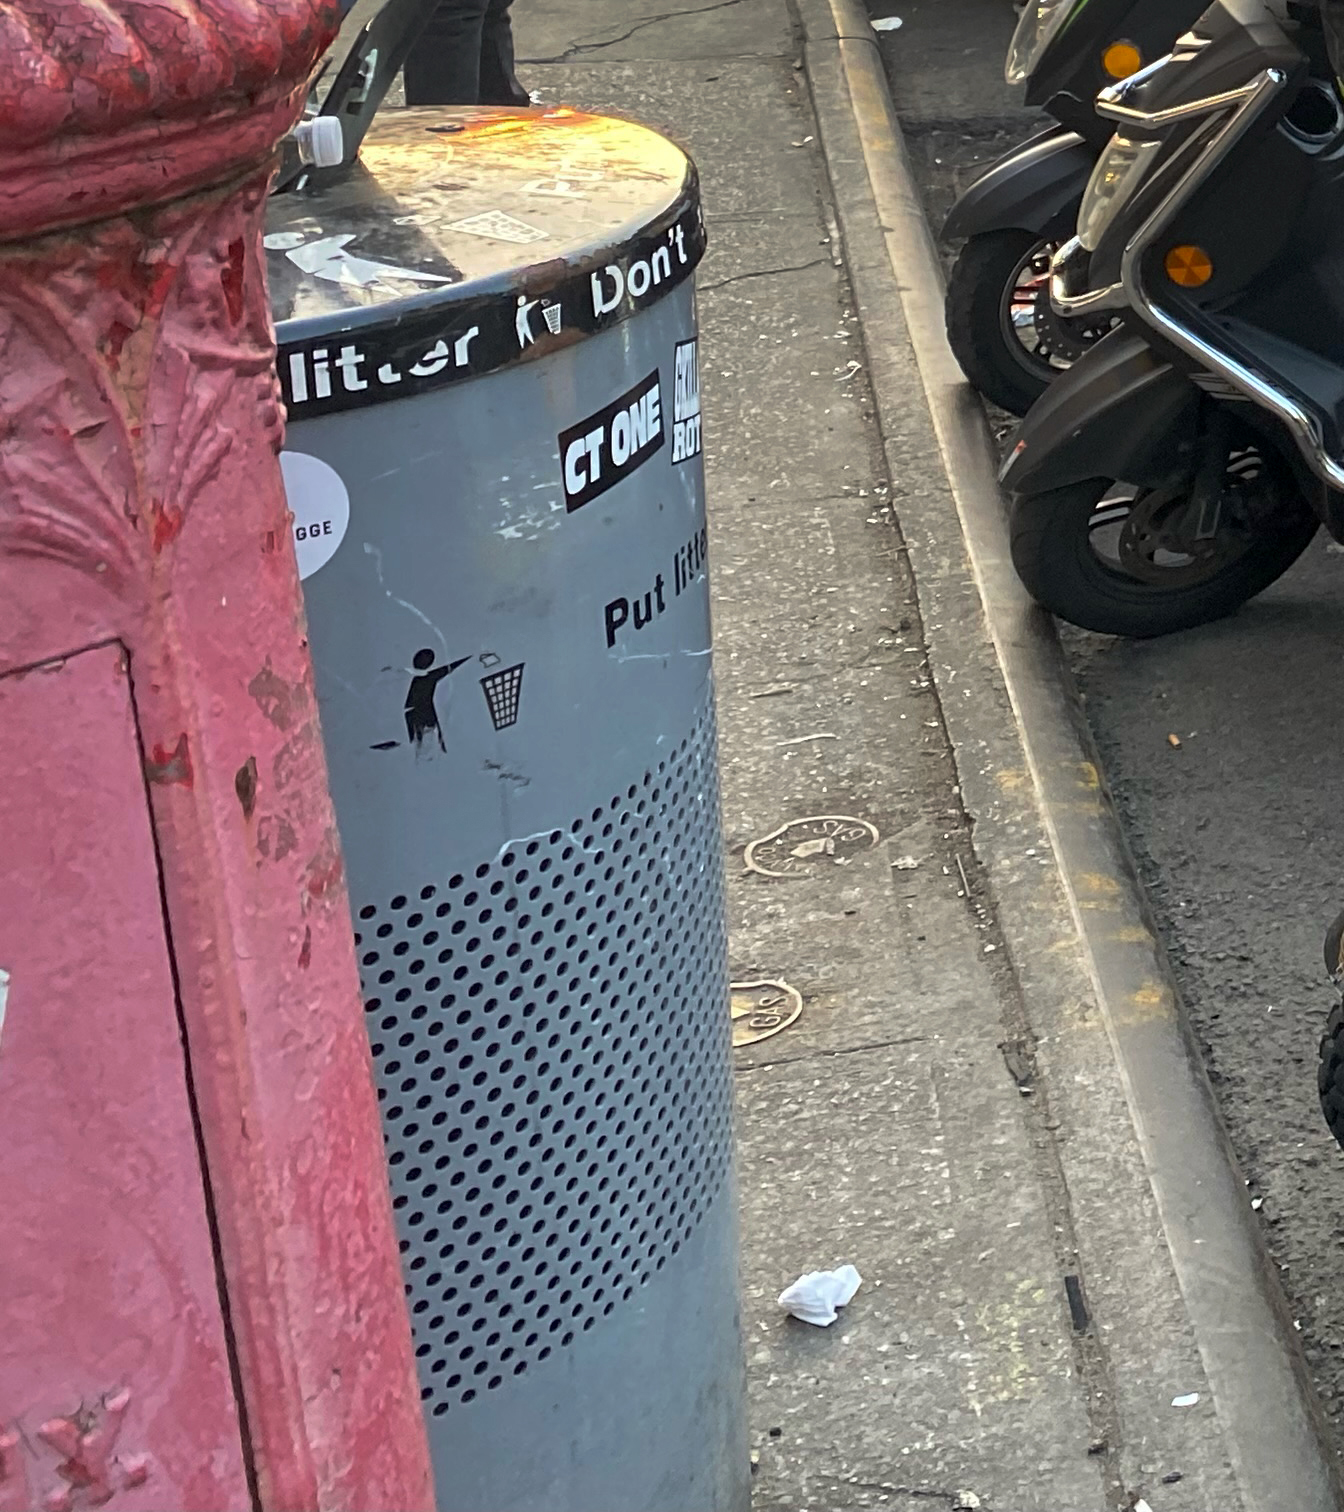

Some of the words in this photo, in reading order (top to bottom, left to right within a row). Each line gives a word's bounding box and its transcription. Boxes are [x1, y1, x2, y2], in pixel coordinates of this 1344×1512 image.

[591, 223, 688, 319] Don't
[564, 425, 604, 495] CT
[611, 382, 661, 467] ONE
[296, 520, 333, 541] GGE
[604, 574, 666, 649] Put
[749, 995, 788, 1027] GAS
